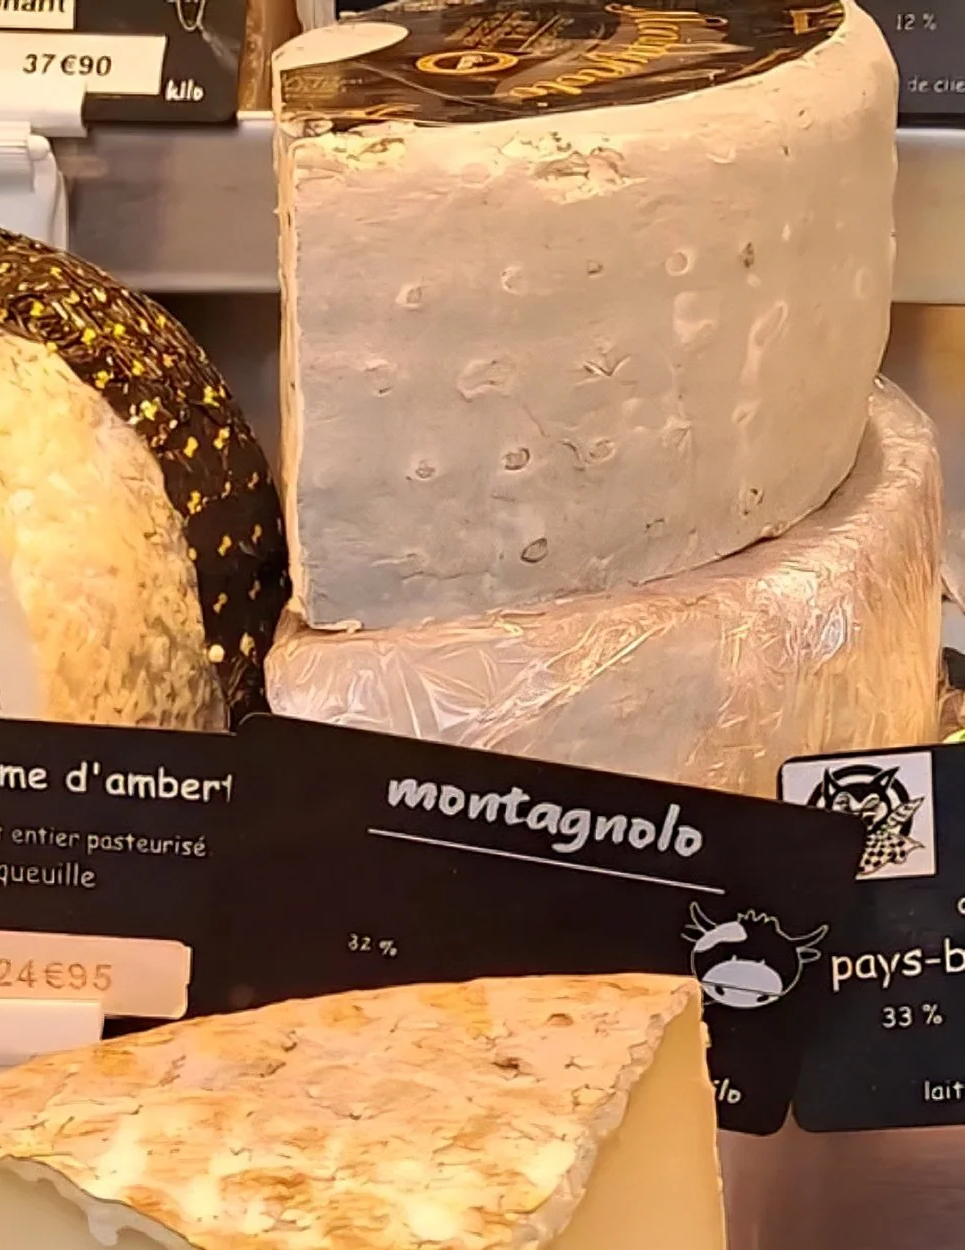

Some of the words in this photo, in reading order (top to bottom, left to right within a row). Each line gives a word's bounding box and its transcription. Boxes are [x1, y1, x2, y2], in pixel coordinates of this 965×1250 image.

[22, 53, 112, 76] 37€90
[165, 79, 204, 101] kilo
[66, 760, 232, 803] d'ambert
[387, 778, 703, 857] montagnolo
[12, 827, 80, 848] entier
[87, 834, 206, 858] pasteurisé
[347, 933, 371, 952] 32
[379, 938, 398, 957] %
[831, 937, 965, 992] pays-b
[882, 1006, 913, 1028] 33
[922, 1003, 943, 1025] %
[924, 1080, 965, 1100] lait
